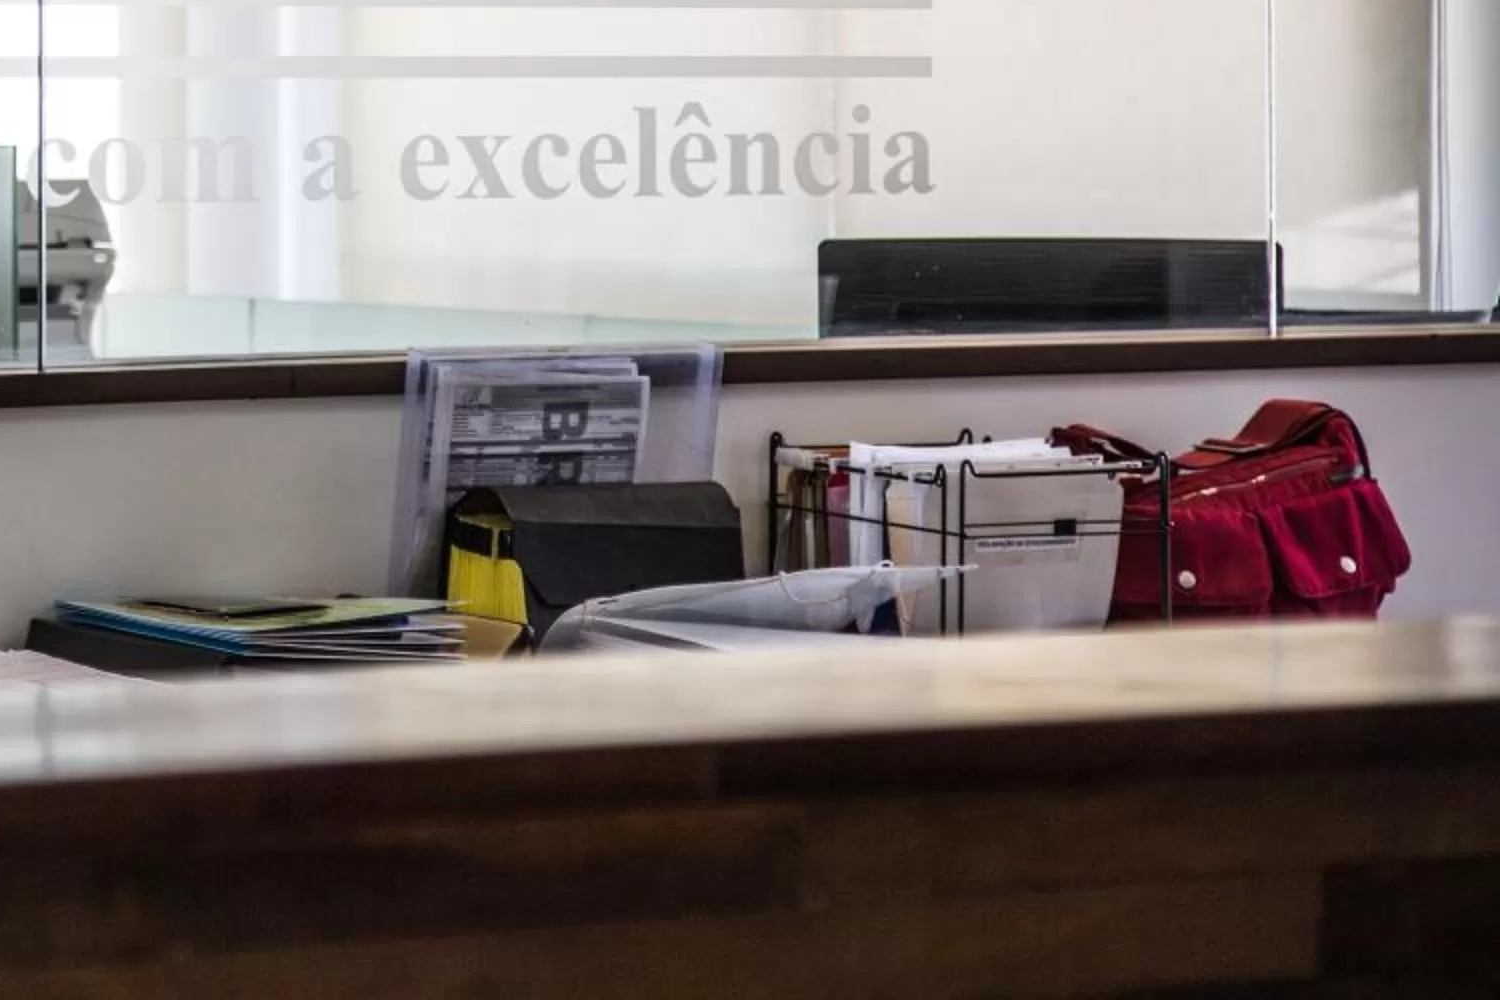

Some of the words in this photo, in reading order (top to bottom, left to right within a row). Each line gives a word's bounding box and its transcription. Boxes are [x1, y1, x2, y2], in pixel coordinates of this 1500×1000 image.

[25, 132, 261, 207] com
[301, 132, 360, 200] a
[399, 100, 935, 204] excelência
